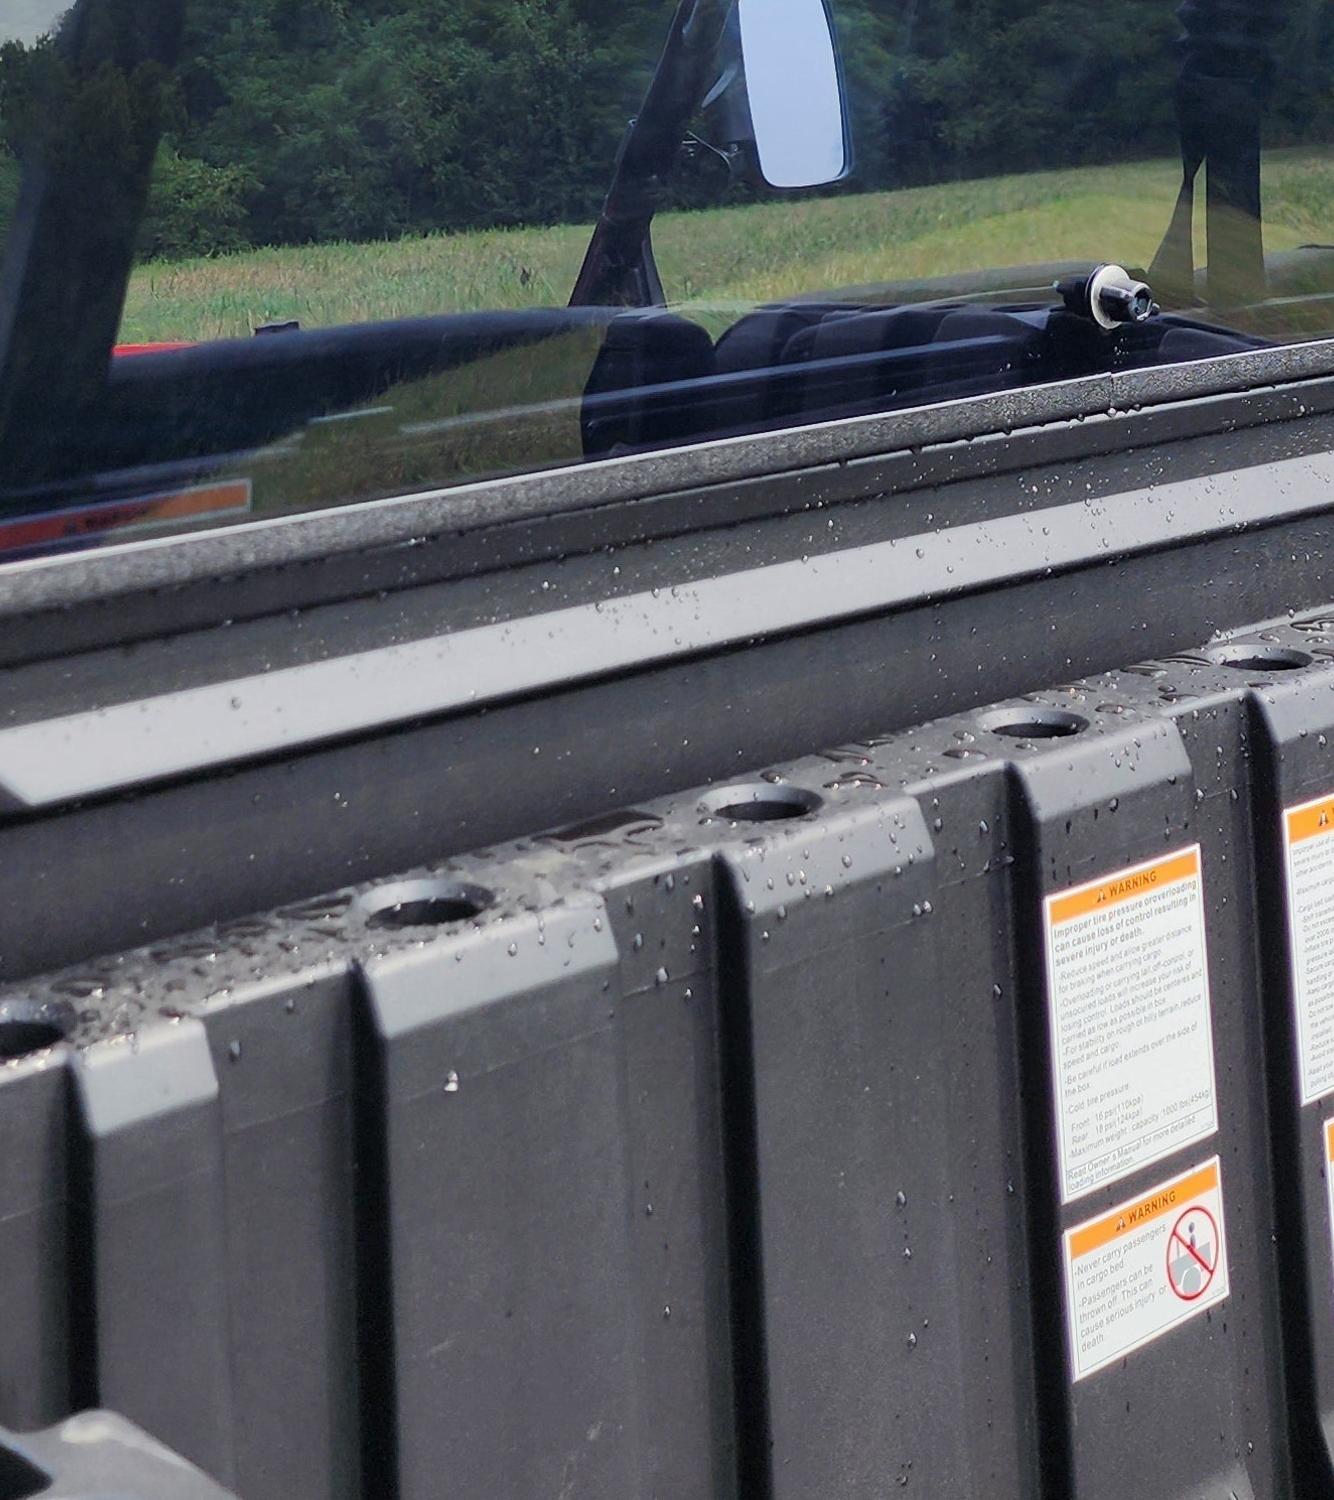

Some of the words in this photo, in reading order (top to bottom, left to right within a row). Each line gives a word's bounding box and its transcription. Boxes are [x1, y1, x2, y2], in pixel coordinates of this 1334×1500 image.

[1109, 870, 1156, 897] WARNING
[1054, 916, 1091, 941] Improper
[1093, 912, 1106, 926] tire
[1108, 899, 1142, 921] pressure
[1072, 931, 1095, 948] cause
[1097, 922, 1113, 938] loss
[1124, 908, 1153, 927] control
[1154, 894, 1188, 918] resulting
[1055, 950, 1083, 968] severe
[1085, 938, 1108, 958] injury
[1088, 955, 1109, 973] speed
[1069, 972, 1095, 992] braking
[1096, 965, 1113, 980] when
[1115, 955, 1141, 974] carrying
[1113, 970, 1139, 989] carrying
[1060, 1017, 1082, 1036] losing
[1110, 997, 1129, 1013] Loads
[1115, 1020, 1135, 1037] rough
[1061, 1027, 1086, 1046] carried
[1062, 1053, 1085, 1073] speed
[1077, 1062, 1102, 1081] careful
[1108, 1053, 1122, 1068] load
[1123, 1041, 1149, 1061] extends
[1150, 1036, 1164, 1049] over
[1087, 1093, 1098, 1106] tire
[1068, 1164, 1086, 1182] Read
[1117, 1138, 1142, 1159] Manual
[1153, 1127, 1169, 1142] more
[1170, 1113, 1195, 1134] detailed
[1105, 1125, 1127, 1146] weight
[1068, 1172, 1094, 1194] loading
[1128, 1190, 1175, 1224] WARNING
[1102, 1246, 1121, 1265] carry
[1123, 1222, 1166, 1254] passengers
[1086, 1267, 1108, 1288] cargo
[1079, 1301, 1106, 1323] thrown
[1122, 1284, 1137, 1301] This
[1080, 1319, 1103, 1338] cause
[1105, 1301, 1133, 1324] serious
[1134, 1289, 1155, 1311] injury
